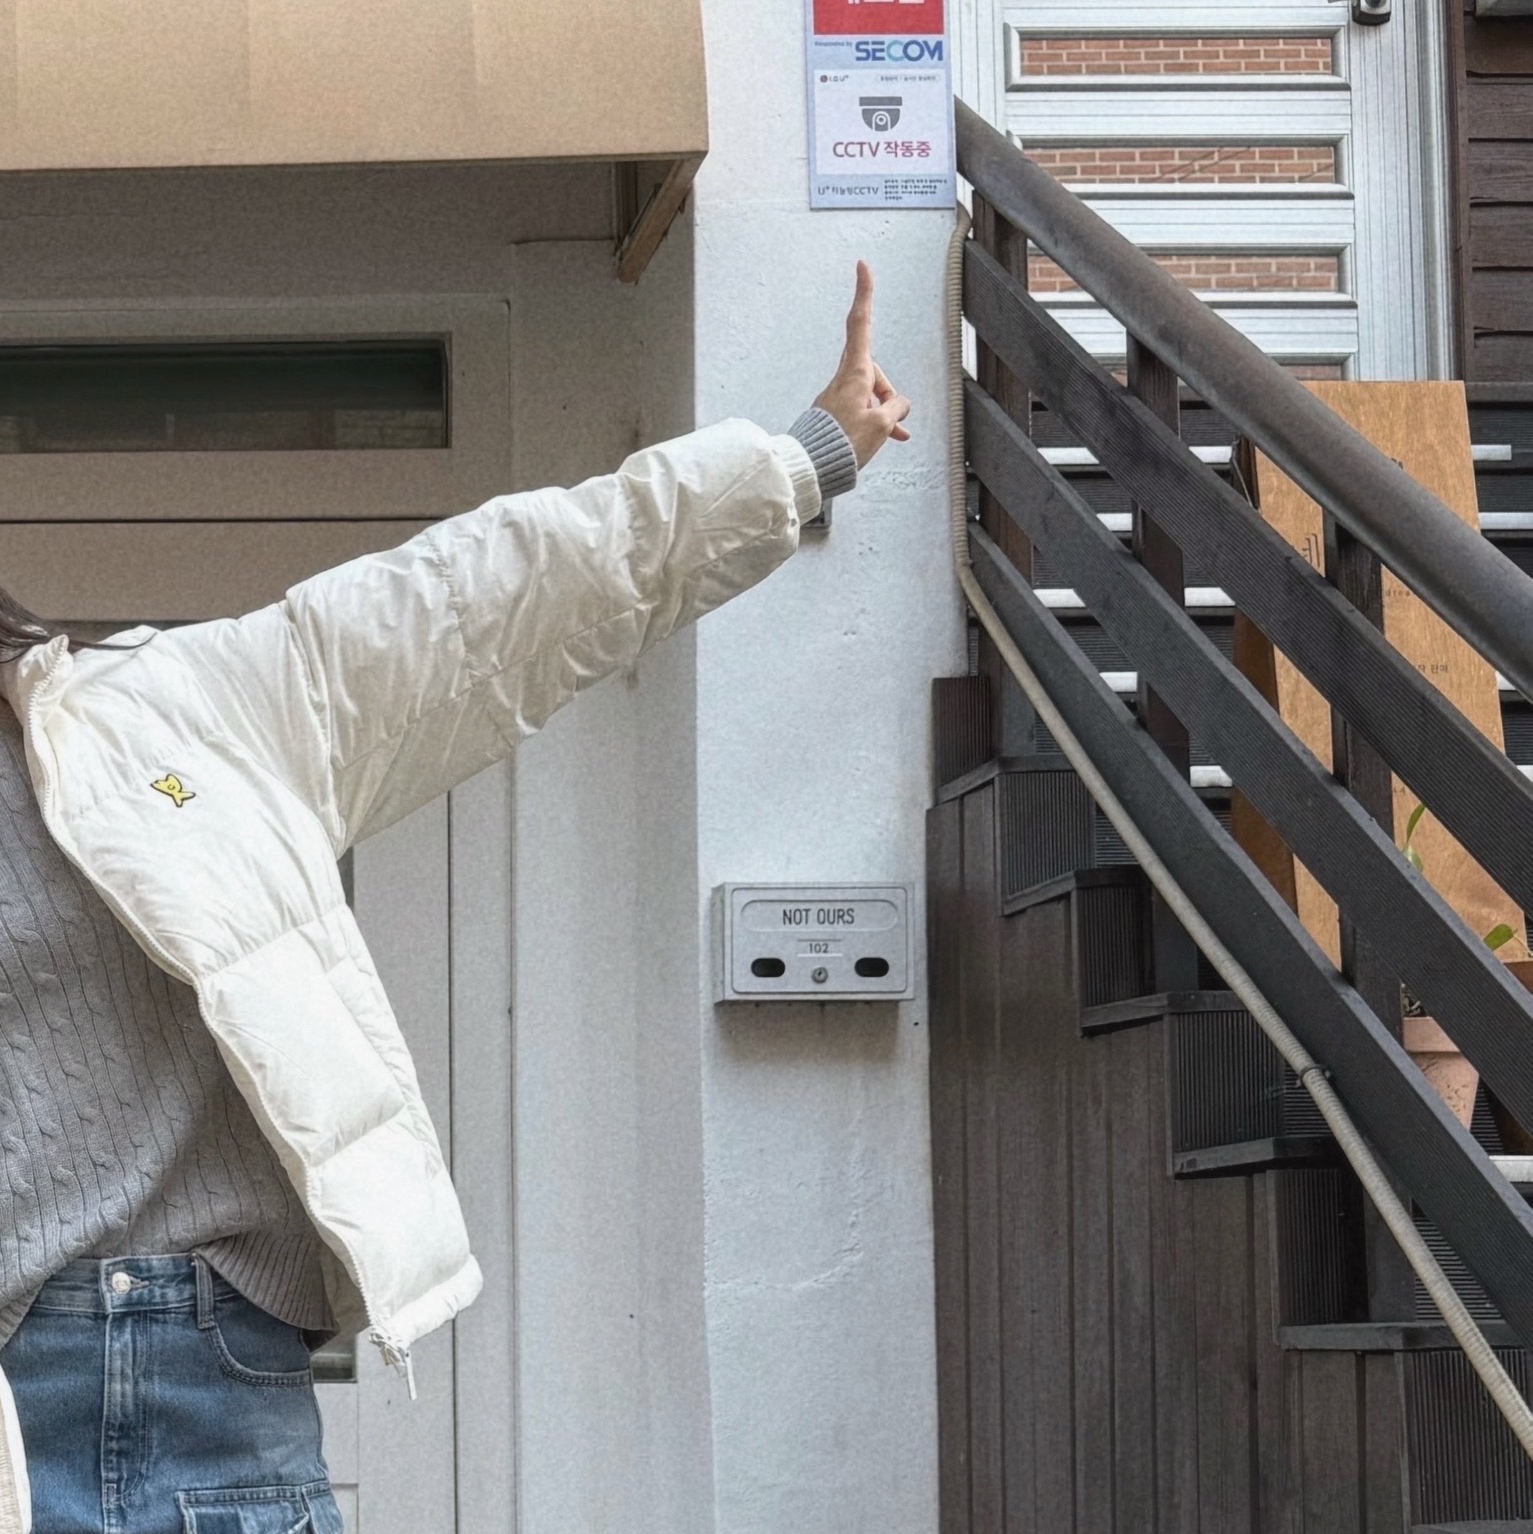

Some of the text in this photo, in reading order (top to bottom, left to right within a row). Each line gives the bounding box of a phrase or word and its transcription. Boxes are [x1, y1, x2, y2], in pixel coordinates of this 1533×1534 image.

[855, 40, 944, 62] SECOM
[832, 141, 932, 158] CCTV 작동중
[782, 908, 855, 926] NOT OURS
[809, 943, 829, 954] 102
